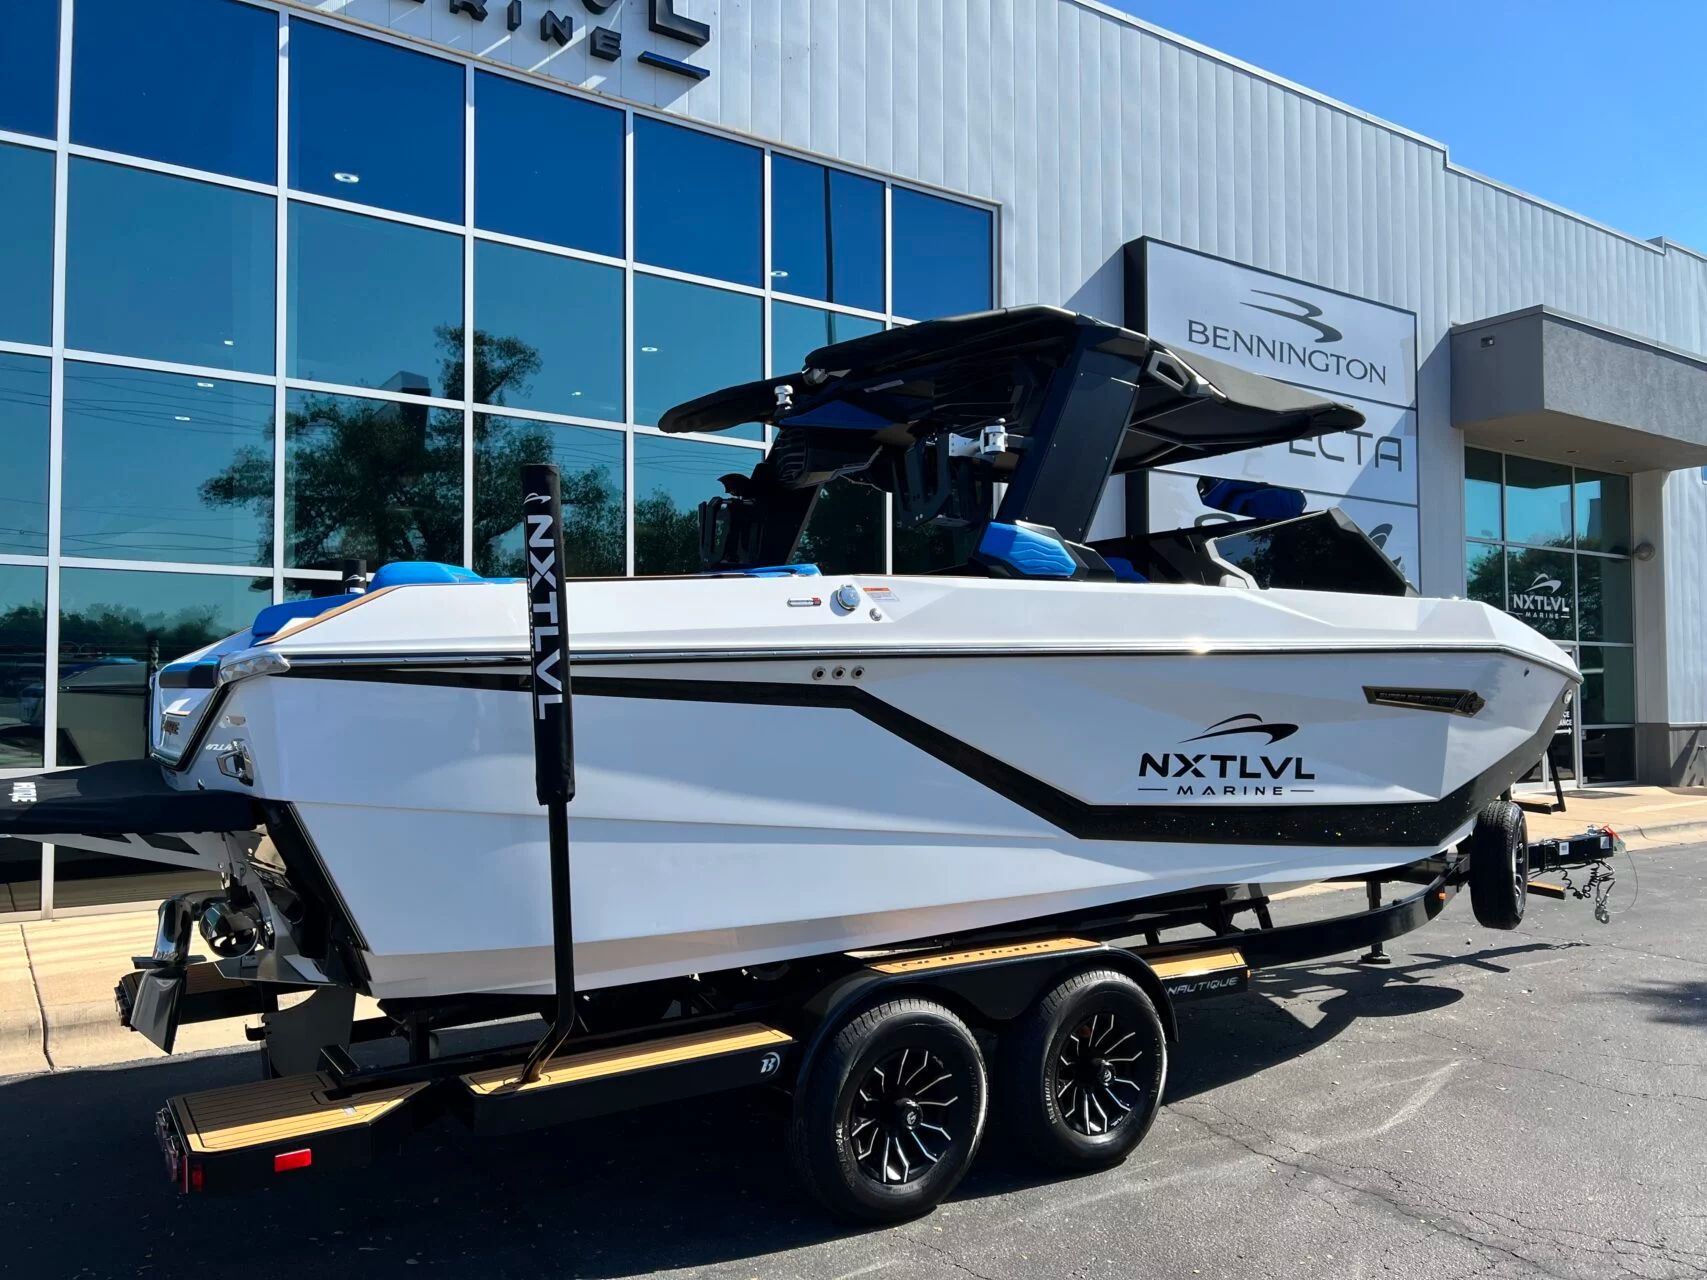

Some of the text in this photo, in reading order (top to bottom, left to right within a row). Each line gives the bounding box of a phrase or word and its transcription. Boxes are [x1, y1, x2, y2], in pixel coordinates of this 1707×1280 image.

[1187, 319, 1387, 386] BENNINGTON
[1288, 429, 1402, 472] ECTA
[1513, 593, 1570, 612] NXTLVL
[527, 514, 563, 720] NXTLVL
[1525, 611, 1559, 619] MARINE
[1138, 752, 1315, 780] NXTLVL
[1176, 785, 1283, 796] MARINE
[1167, 976, 1239, 995] NAUTIQUE
